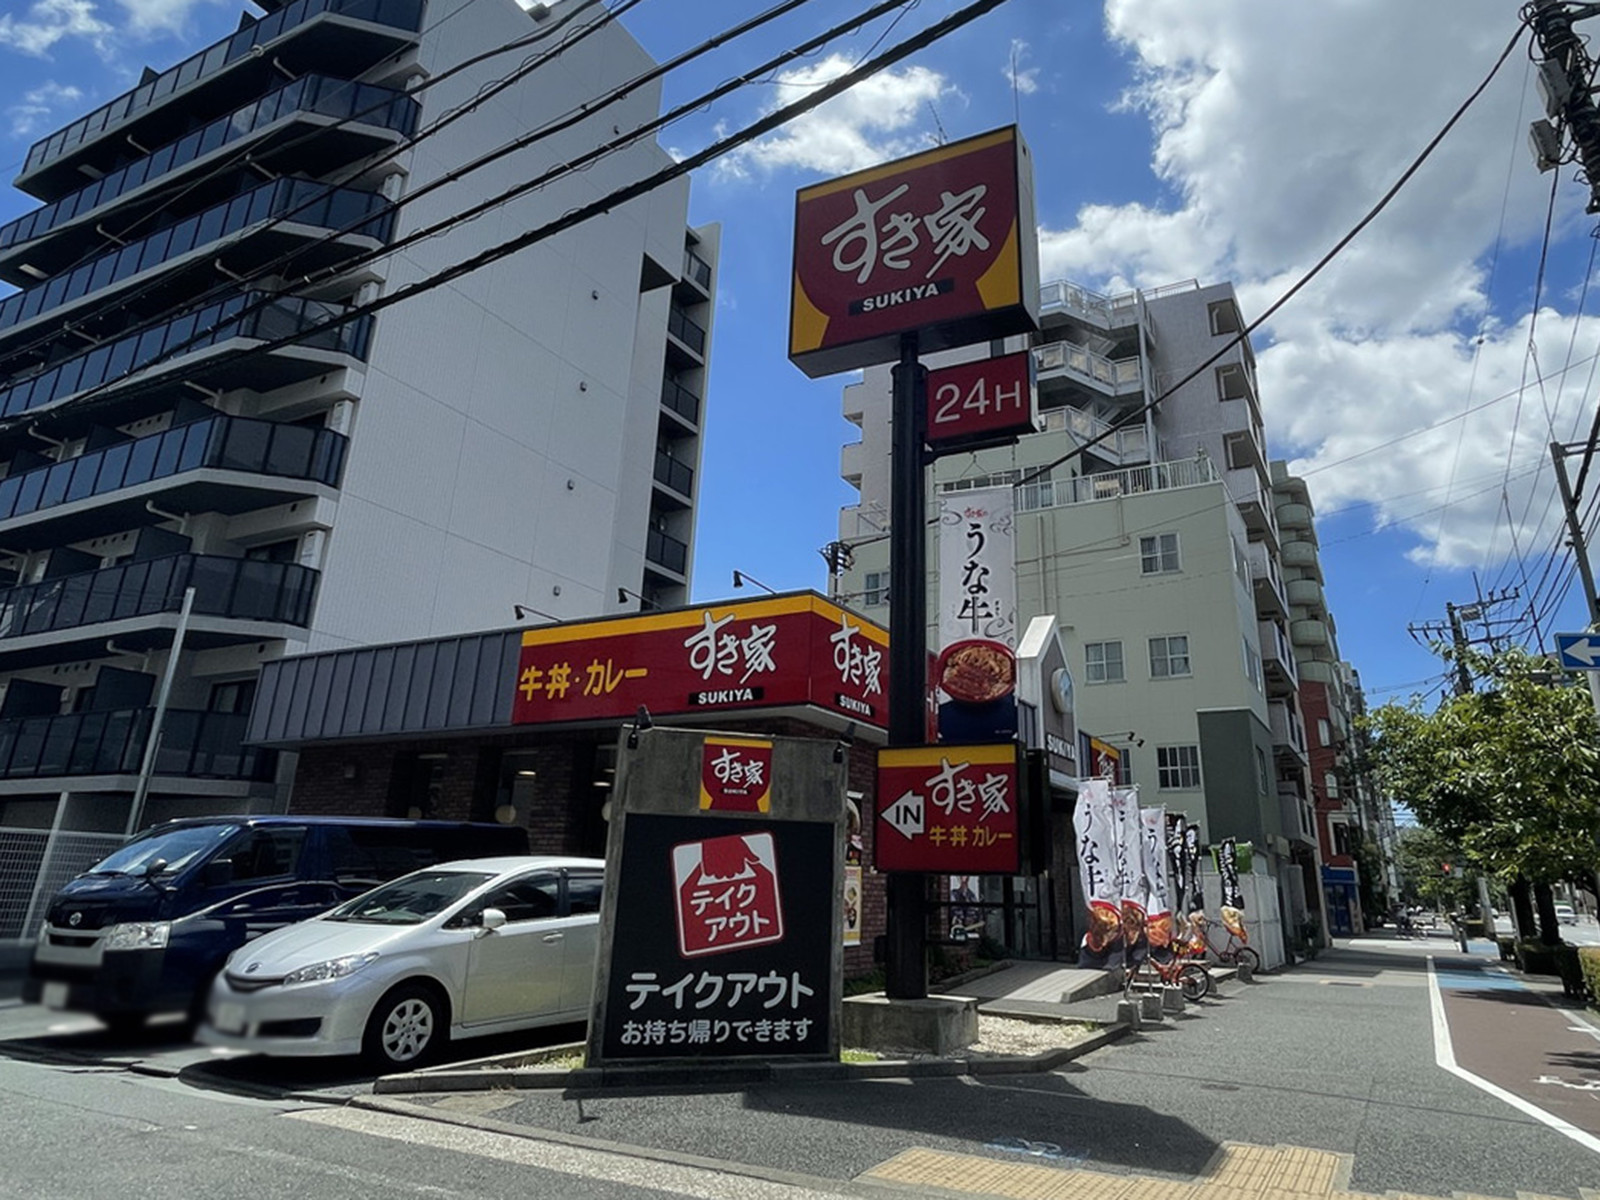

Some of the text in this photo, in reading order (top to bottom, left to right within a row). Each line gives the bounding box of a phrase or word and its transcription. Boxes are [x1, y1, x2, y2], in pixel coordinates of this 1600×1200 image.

[820, 184, 990, 284] すき家
[862, 282, 939, 312] SUKIYA
[935, 377, 1022, 423] 24H
[957, 523, 993, 635] うな牛
[684, 611, 778, 684] すき家
[830, 613, 882, 698] すき家
[698, 688, 753, 705] SUKIYA
[840, 695, 871, 716] SUKIYA
[711, 748, 764, 788] すき家
[925, 758, 1010, 821] すき家
[895, 804, 920, 825] IN
[690, 883, 757, 916] テイク
[704, 910, 770, 942] アウト
[626, 970, 814, 1010] テイクアウト
[620, 1017, 813, 1046] お持ち帰りできます
